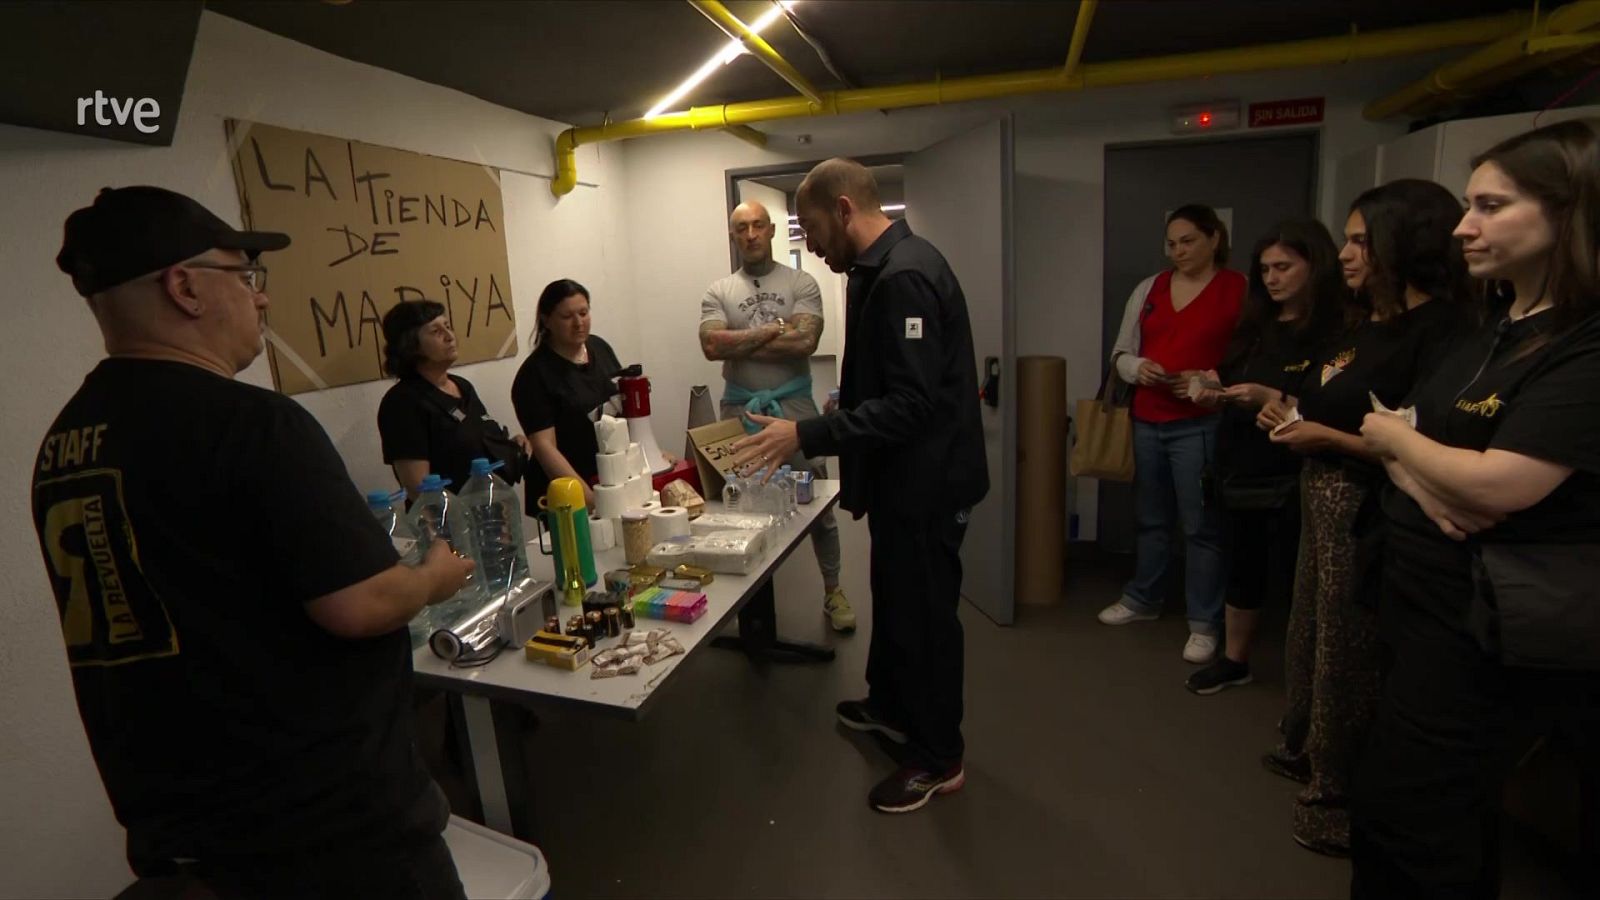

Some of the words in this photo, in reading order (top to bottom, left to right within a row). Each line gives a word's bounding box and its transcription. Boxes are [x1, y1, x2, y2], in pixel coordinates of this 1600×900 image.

[251, 136, 338, 200] LA
[327, 225, 400, 267] DE
[41, 423, 108, 471] STAFF
[84, 498, 124, 605] REVUELTA
[112, 612, 141, 640] LA
